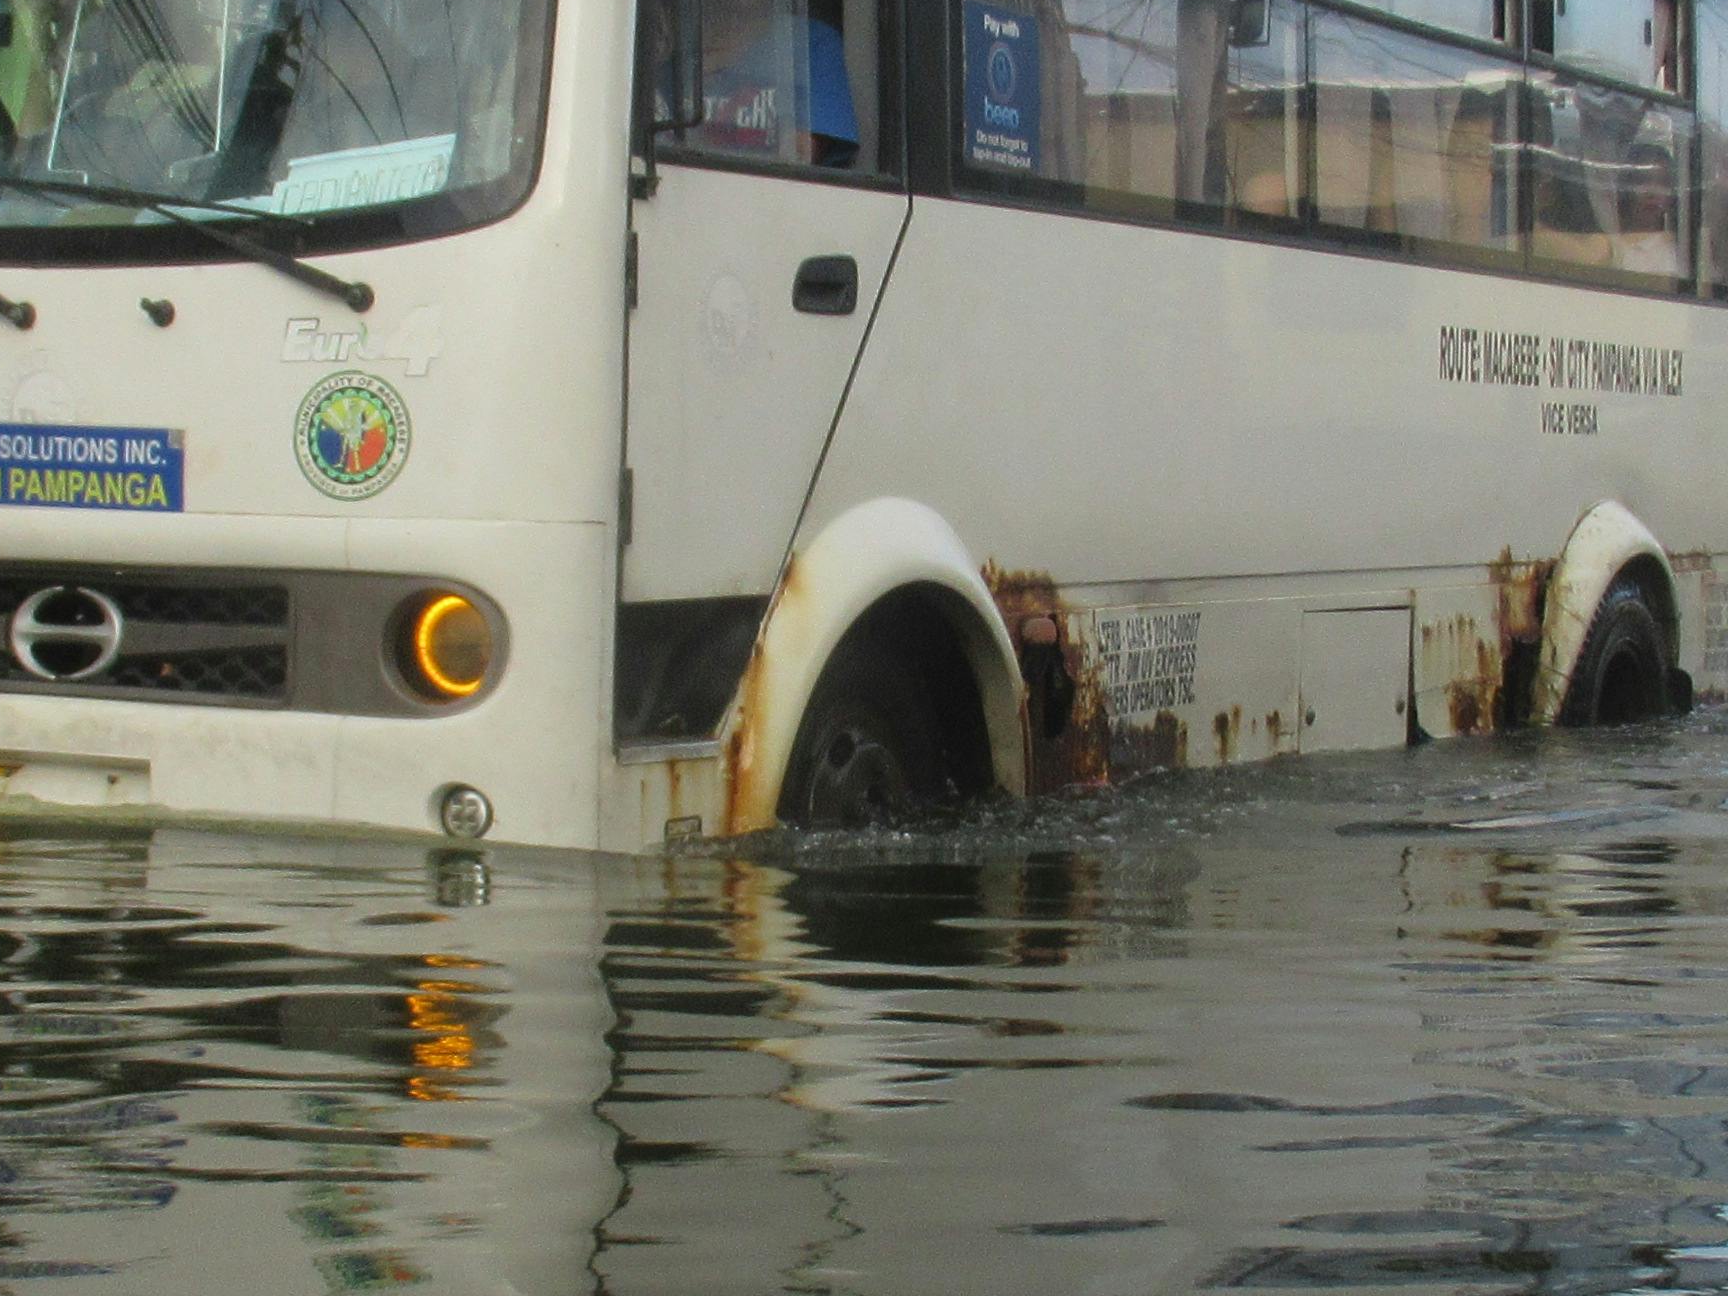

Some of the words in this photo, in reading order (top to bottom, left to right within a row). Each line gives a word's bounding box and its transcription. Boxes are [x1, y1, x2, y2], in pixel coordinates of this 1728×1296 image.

[984, 14, 999, 38] Pay
[1001, 20, 1020, 39] with
[984, 95, 1020, 129] beep
[1440, 325, 1481, 384] ROUTE:
[1482, 330, 1541, 387] MACABEBE
[1549, 336, 1564, 389] SM
[1566, 337, 1590, 391] CITY
[1591, 340, 1642, 394] PAMPANGA
[298, 376, 353, 437] MUNICIPALITY
[357, 376, 374, 388] OF
[1540, 402, 1564, 433] VICE
[1566, 404, 1598, 435] VERSA
[124, 439, 167, 465] INC.
[9, 467, 168, 507] PAMPANGA
